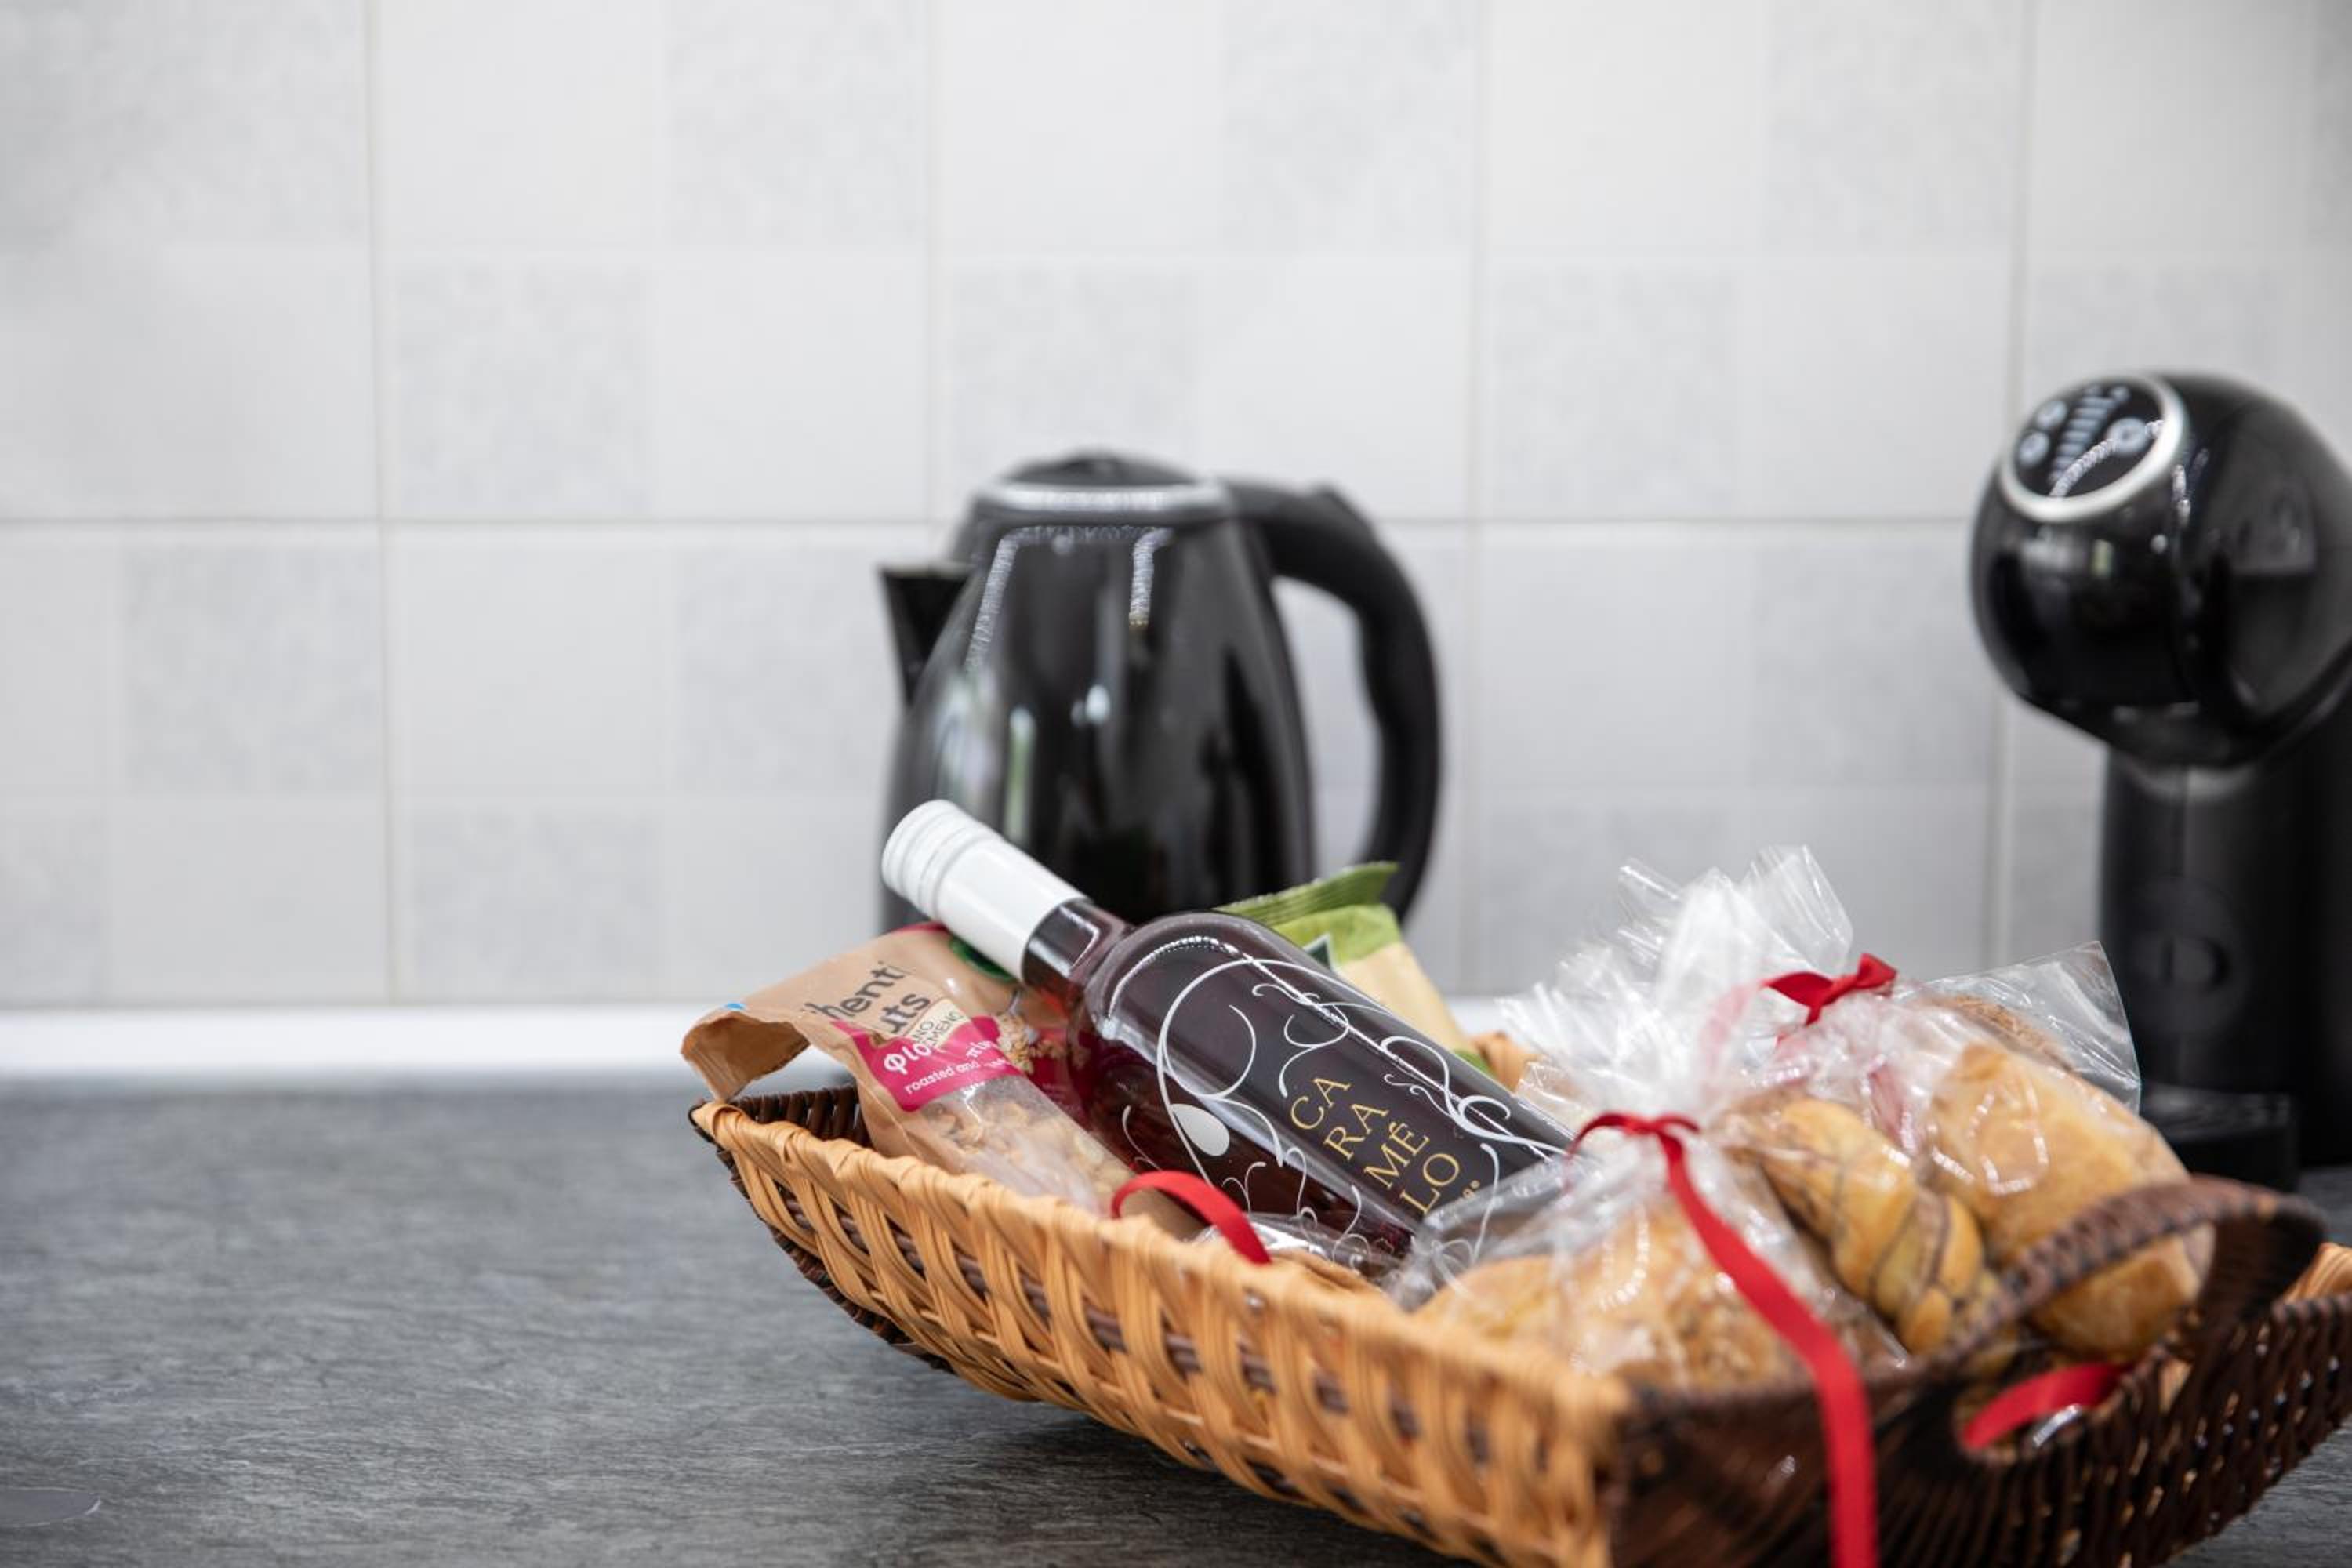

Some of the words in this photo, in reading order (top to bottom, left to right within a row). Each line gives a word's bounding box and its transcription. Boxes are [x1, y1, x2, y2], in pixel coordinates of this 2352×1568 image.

[802, 961, 915, 1020] henti
[905, 1066, 956, 1094] roasted
[1290, 1077, 1351, 1129] CA
[1323, 1103, 1389, 1160] RA
[1399, 1152, 1459, 1214] LO
